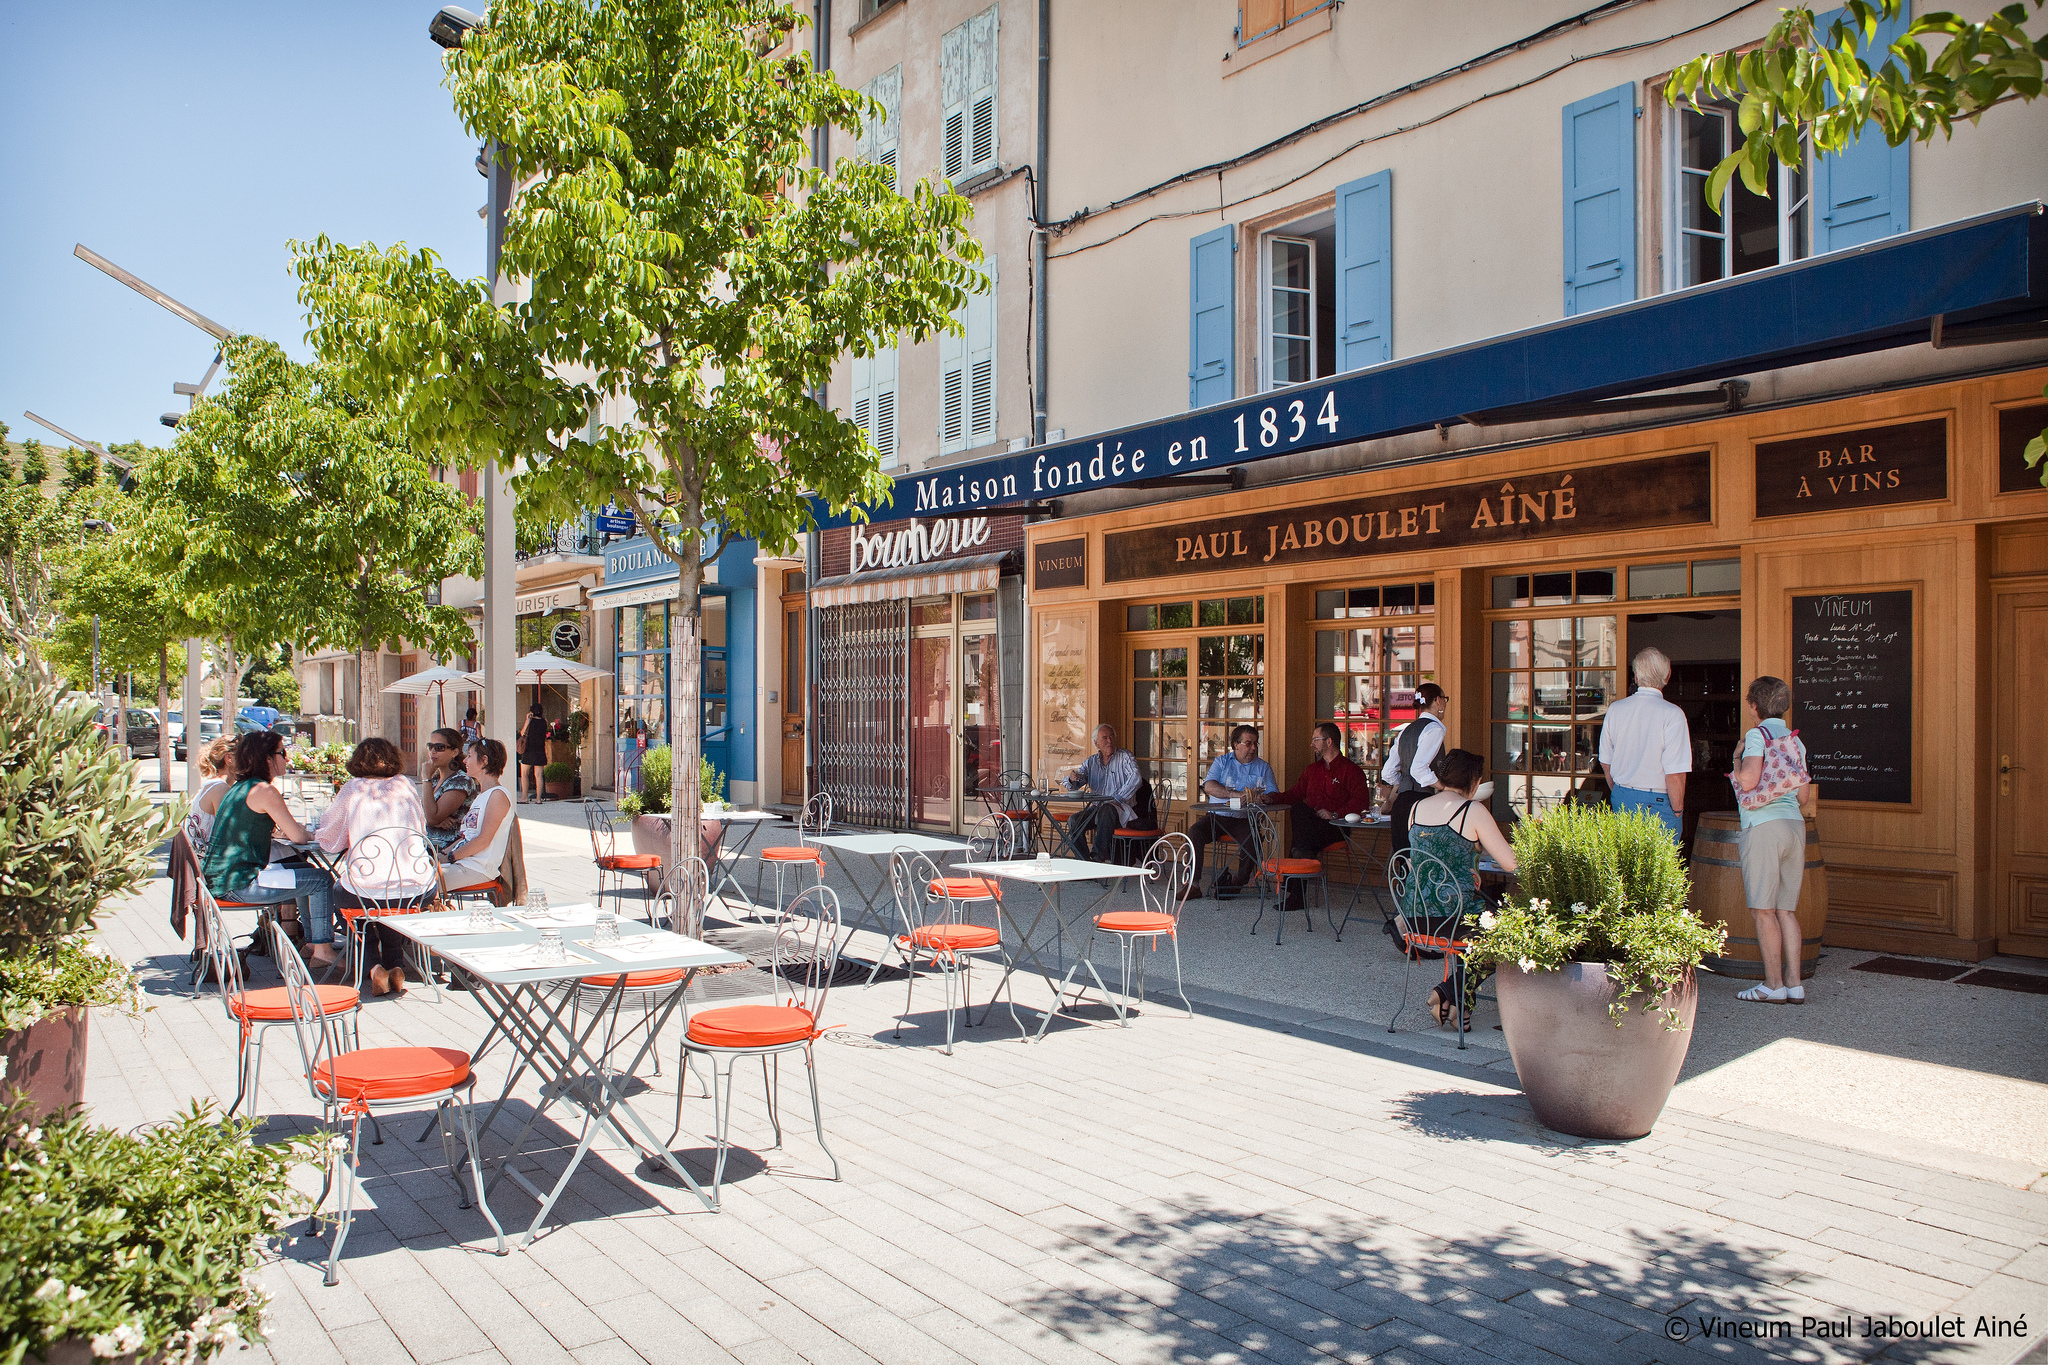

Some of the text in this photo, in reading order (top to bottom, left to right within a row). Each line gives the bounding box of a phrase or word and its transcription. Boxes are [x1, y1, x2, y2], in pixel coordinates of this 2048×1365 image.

[915, 390, 1339, 512] Maison fondée en 1834
[1817, 444, 1876, 468] BAR
[1796, 468, 1900, 498] À VINS
[1175, 473, 1577, 562] PAUL JABOULET AÎNÉ
[851, 507, 992, 574] Boucherie
[1038, 555, 1082, 571] VINEUM
[516, 594, 559, 613] URISTE
[1814, 596, 1872, 617] VINEUM
[1803, 700, 1821, 711] Tous
